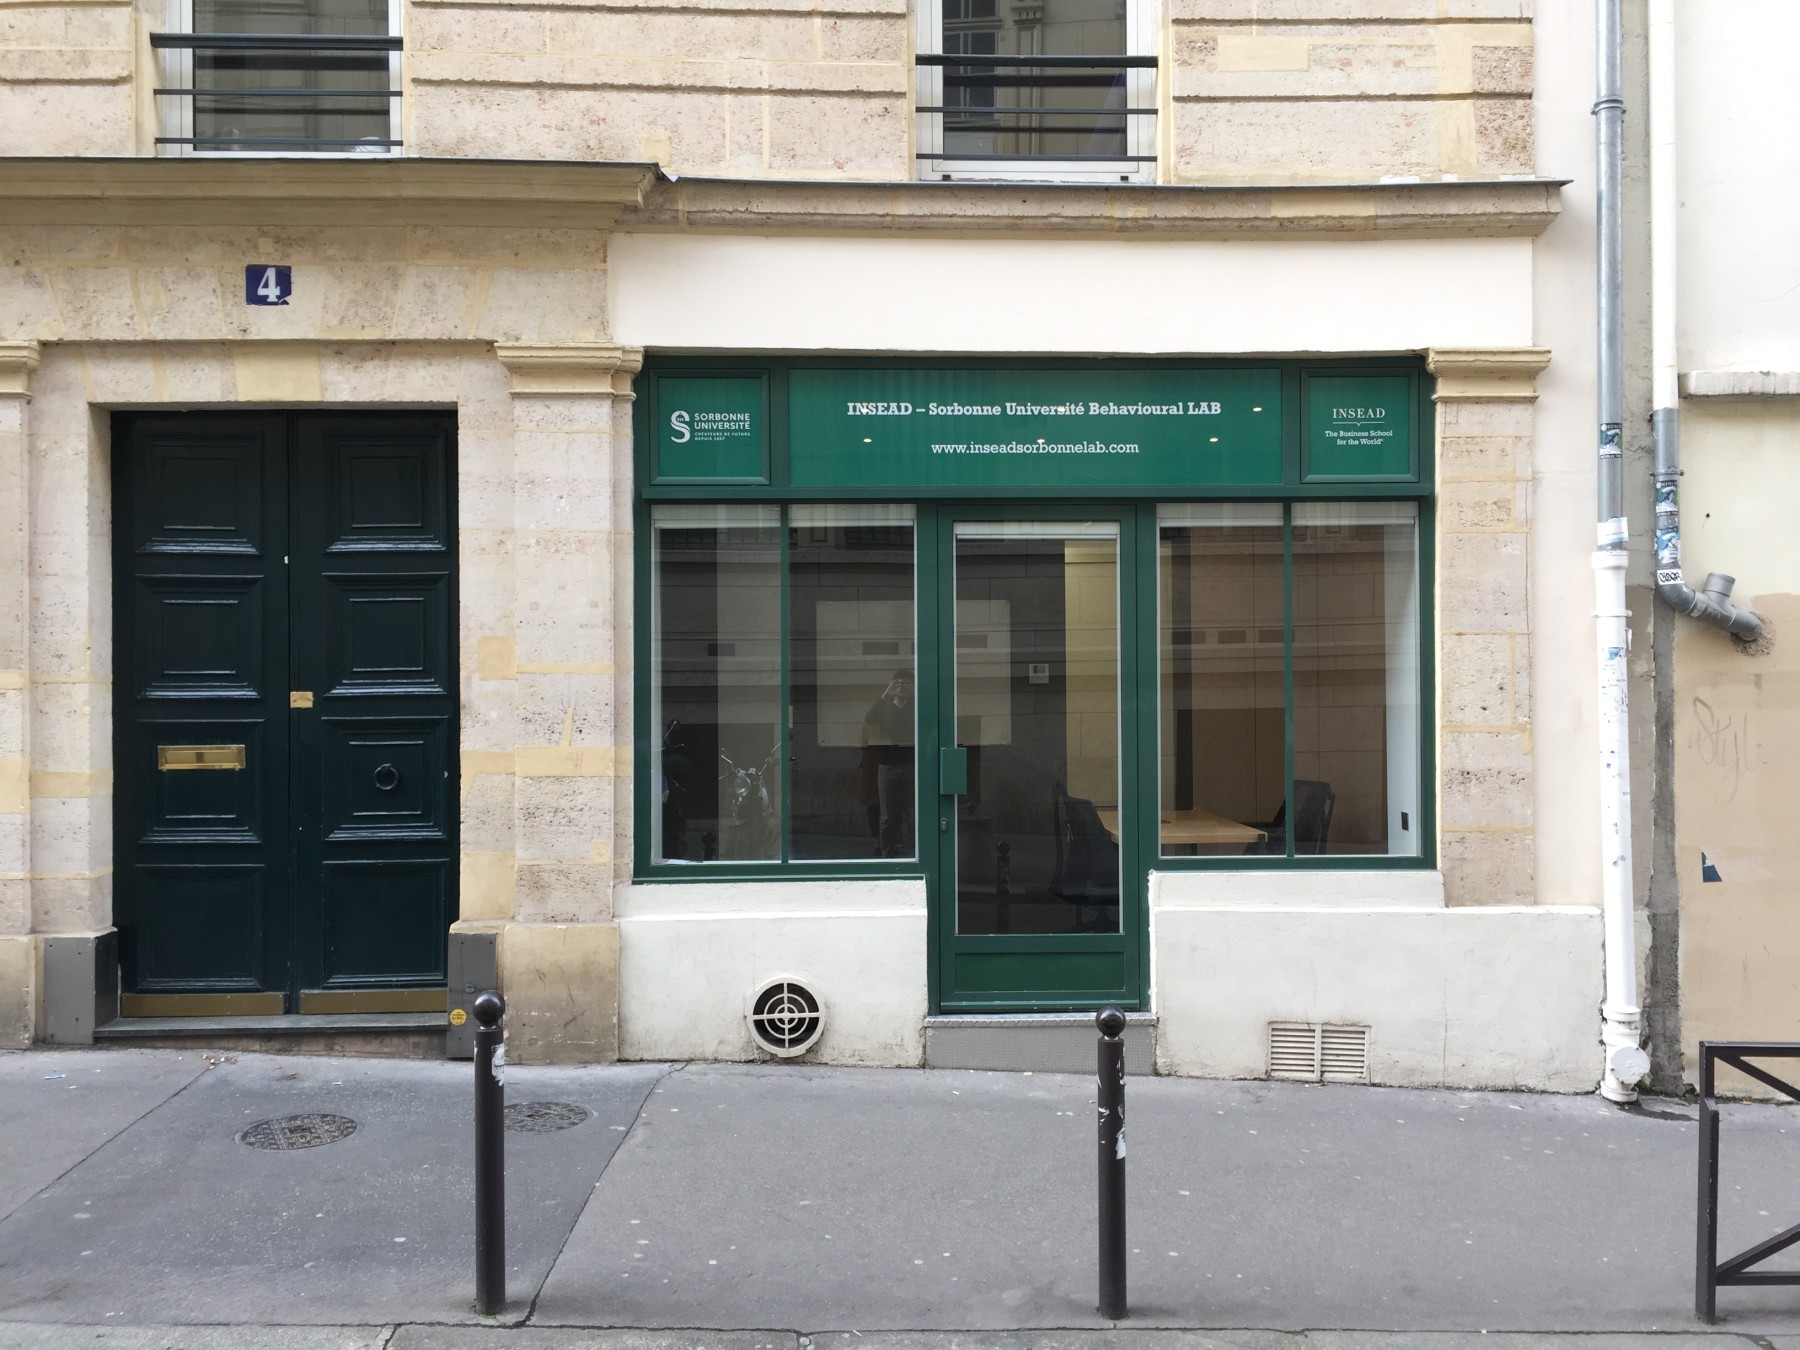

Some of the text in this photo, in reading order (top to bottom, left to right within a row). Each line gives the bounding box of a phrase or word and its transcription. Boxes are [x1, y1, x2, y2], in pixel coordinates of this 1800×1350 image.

[257, 267, 281, 302] 4
[847, 402, 913, 416] INSEAD
[929, 402, 1002, 416] Sorbonne
[1005, 402, 1085, 416] Université
[1088, 402, 1184, 416] Behavioural
[1187, 402, 1222, 415] LAB
[1332, 407, 1386, 419] INSEAD
[694, 413, 751, 421] SORBONNE
[694, 420, 751, 430] UNIVERSITÉ
[1369, 429, 1393, 437] School
[931, 441, 1140, 454] www.inseadsorbonnelab.com
[1336, 438, 1347, 446] for
[1347, 438, 1360, 446] the
